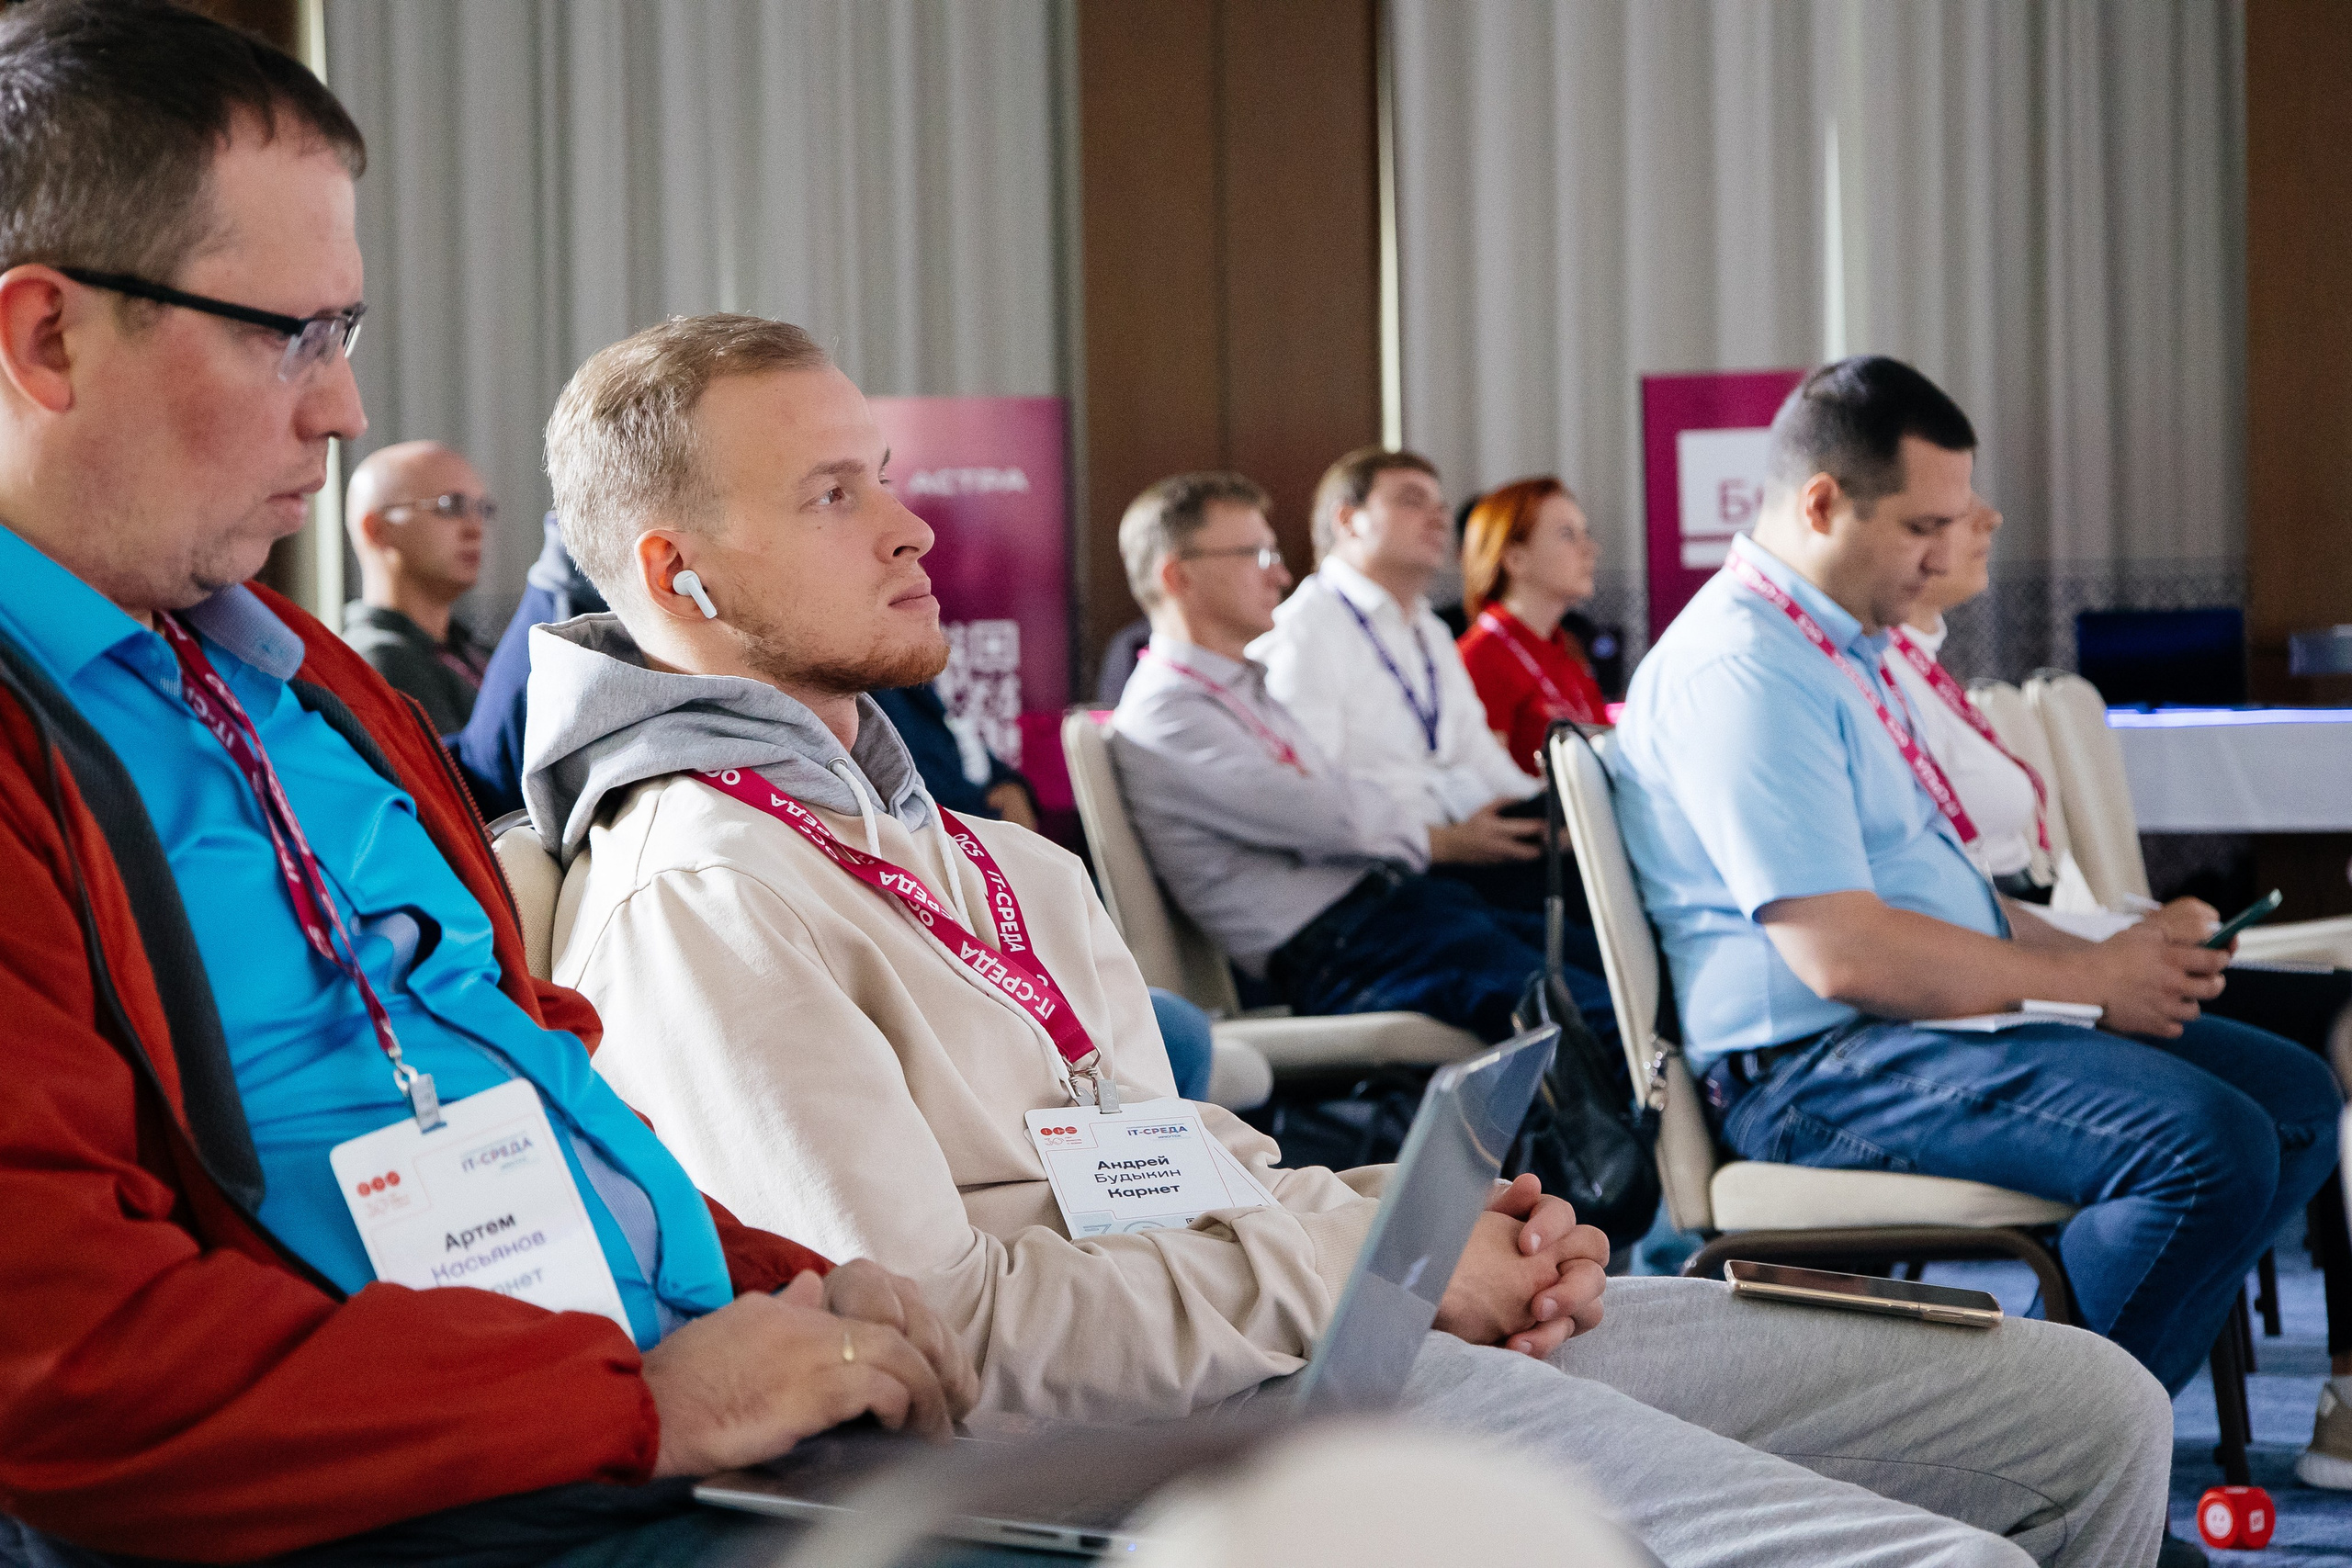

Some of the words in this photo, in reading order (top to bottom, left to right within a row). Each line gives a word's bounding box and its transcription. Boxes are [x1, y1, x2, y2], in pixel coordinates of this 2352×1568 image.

[953, 833, 985, 857] OCS
[987, 869, 1026, 952] IT-СРЕДА
[960, 940, 1056, 1020] IT-СРЕДА
[1127, 1125, 1188, 1136] IT-СРЕДА
[1097, 1155, 1170, 1171] Андрей
[1093, 1168, 1182, 1185] Будыкин
[1107, 1183, 1181, 1198] Карнет
[444, 1213, 515, 1253] Артем
